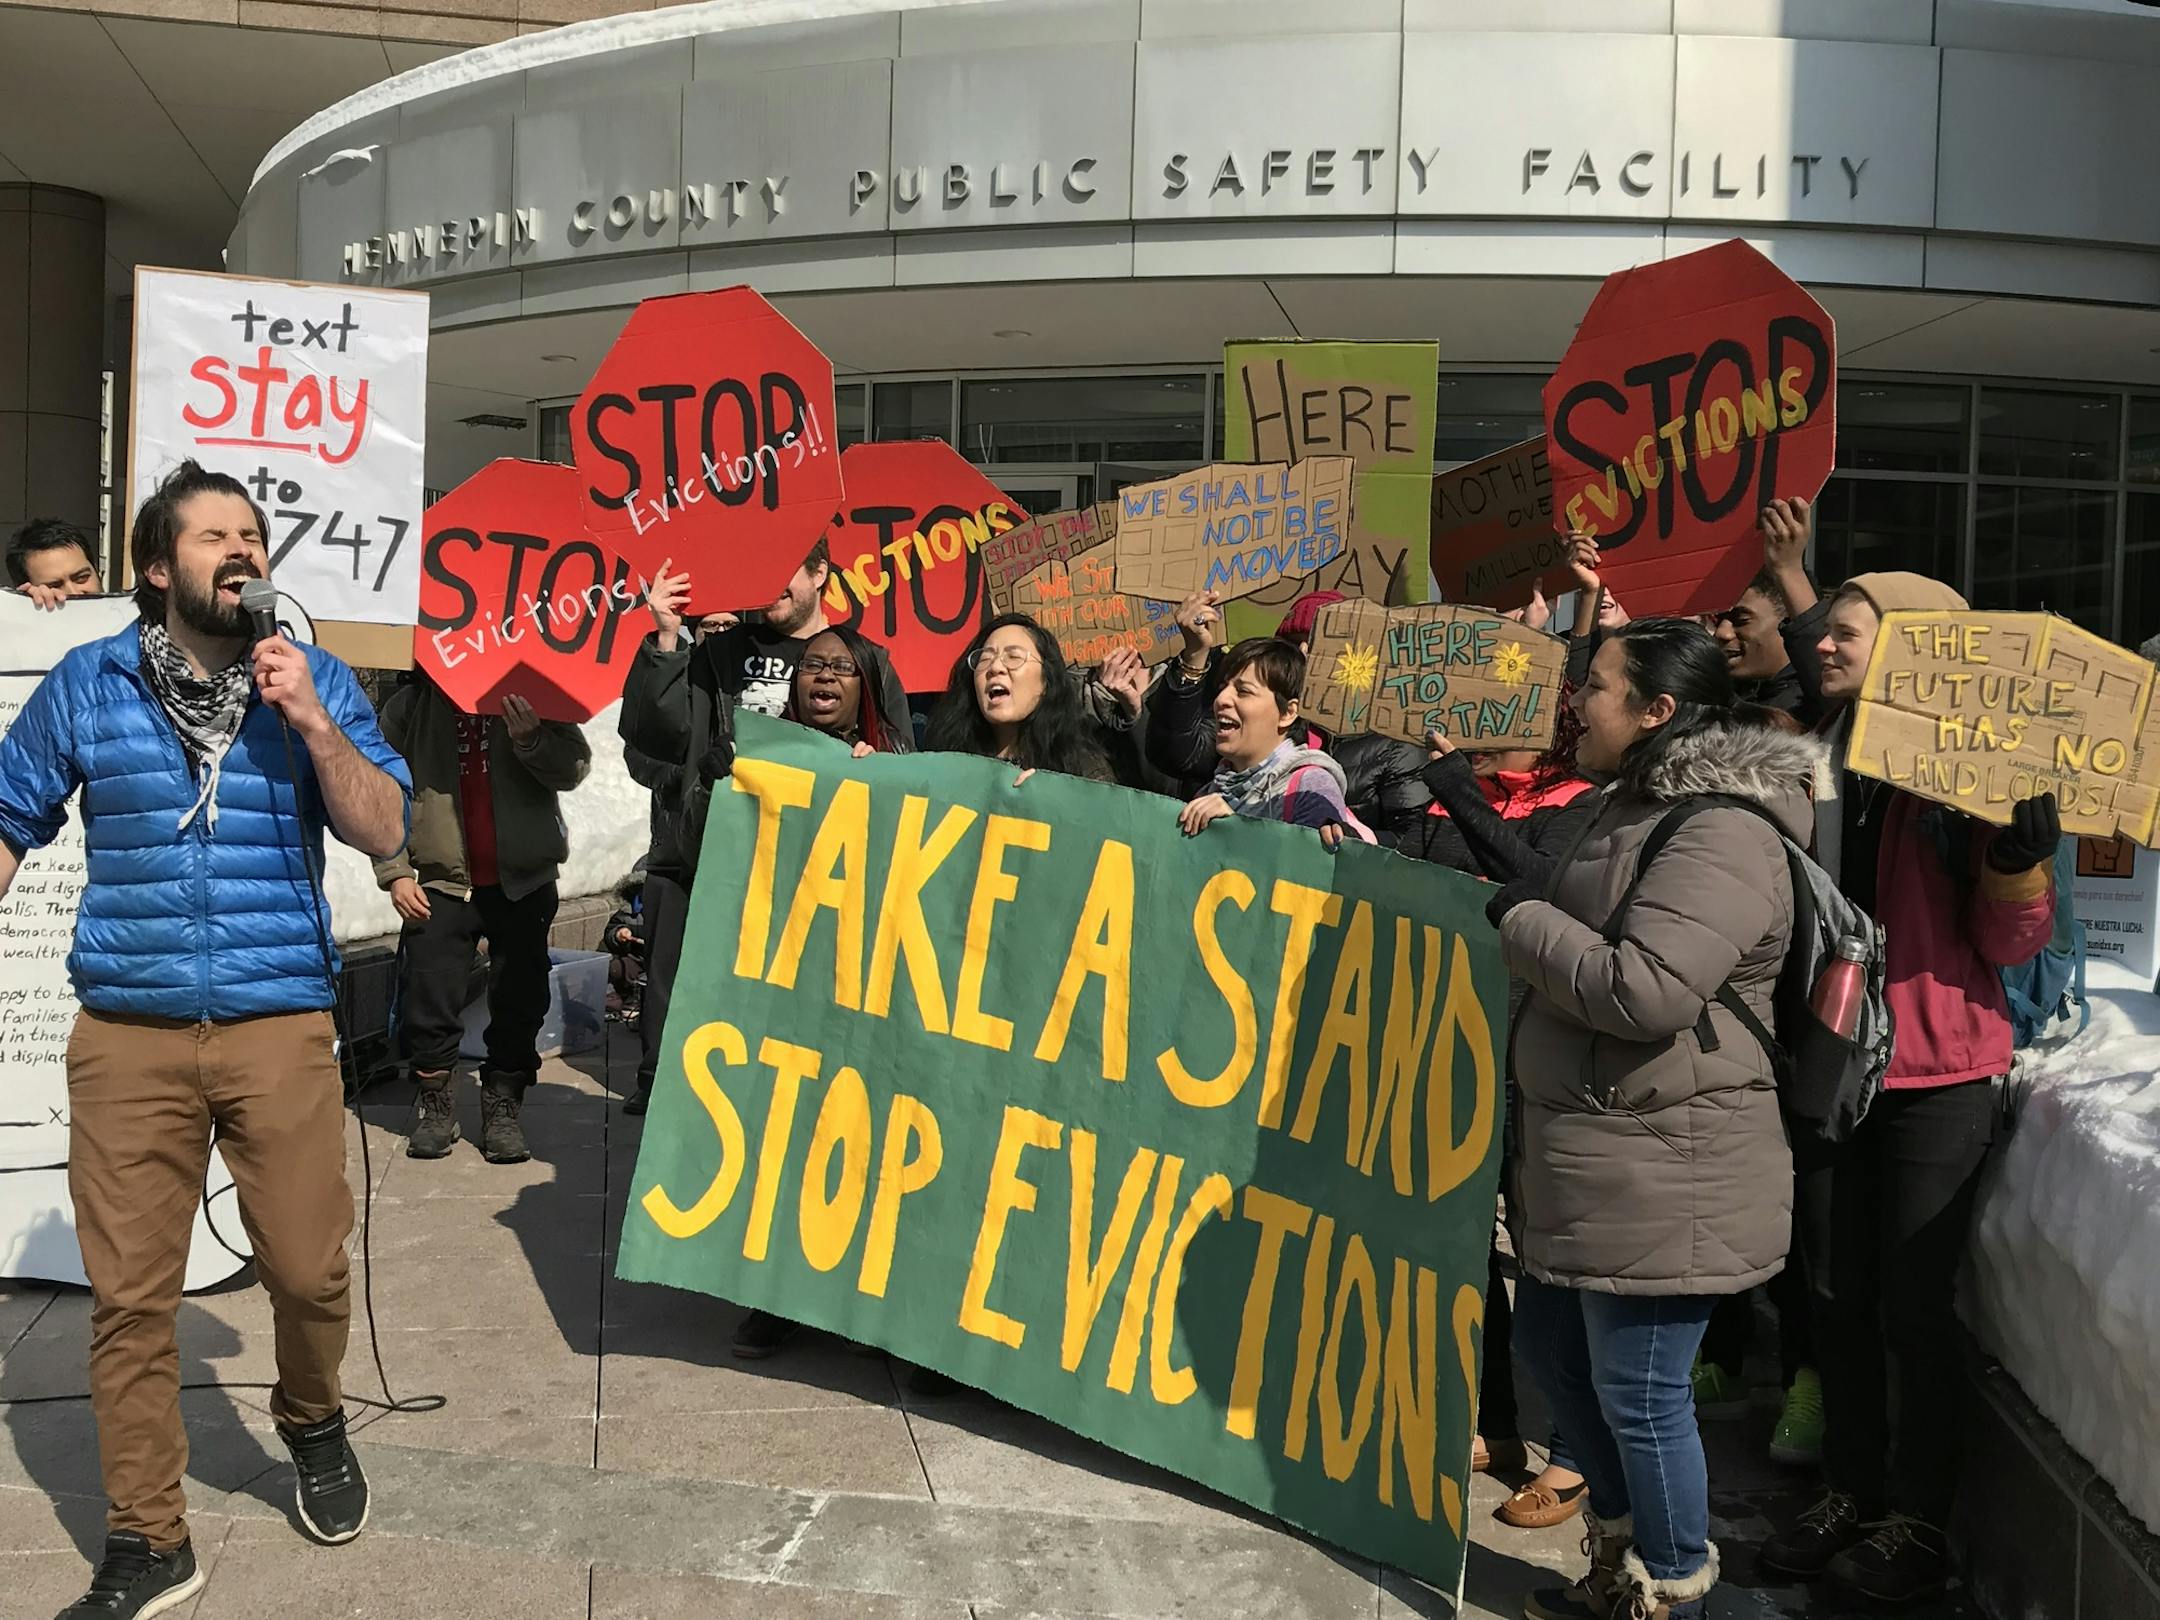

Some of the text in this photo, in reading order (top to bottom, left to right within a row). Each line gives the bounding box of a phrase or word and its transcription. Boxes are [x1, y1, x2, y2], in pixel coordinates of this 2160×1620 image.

[343, 146, 1869, 275] HENNEPIN COUNTY PUBLIC SAFETY FACILITY
[231, 299, 359, 353] text
[1242, 358, 1416, 465] HERE
[1553, 315, 1830, 551] STOP
[586, 372, 807, 512] STOP
[624, 402, 828, 536] Evictions!!
[1565, 366, 1808, 540] EVICTIONS
[248, 466, 302, 505] to
[1123, 470, 1300, 519] WE SHALL
[1202, 500, 1335, 546] NOT BE
[822, 502, 1014, 624] VICTIONS
[1203, 534, 1341, 591] MOVED
[1080, 595, 1130, 623] OUR
[1387, 620, 1504, 667] HERE
[1902, 624, 1992, 665] THE
[1384, 672, 1447, 708] TO
[1423, 684, 1542, 740] STAY!
[1884, 670, 2077, 716] FUTURE
[1935, 714, 2030, 753] HAS
[2055, 733, 2127, 776] NO
[2007, 758, 2039, 773] LARGE
[0, 901, 37, 917] olis.
[17, 880, 48, 895] and
[34, 986, 51, 1000] to
[731, 757, 1494, 1204] TAKE A STAND
[641, 1020, 943, 1299] STOP
